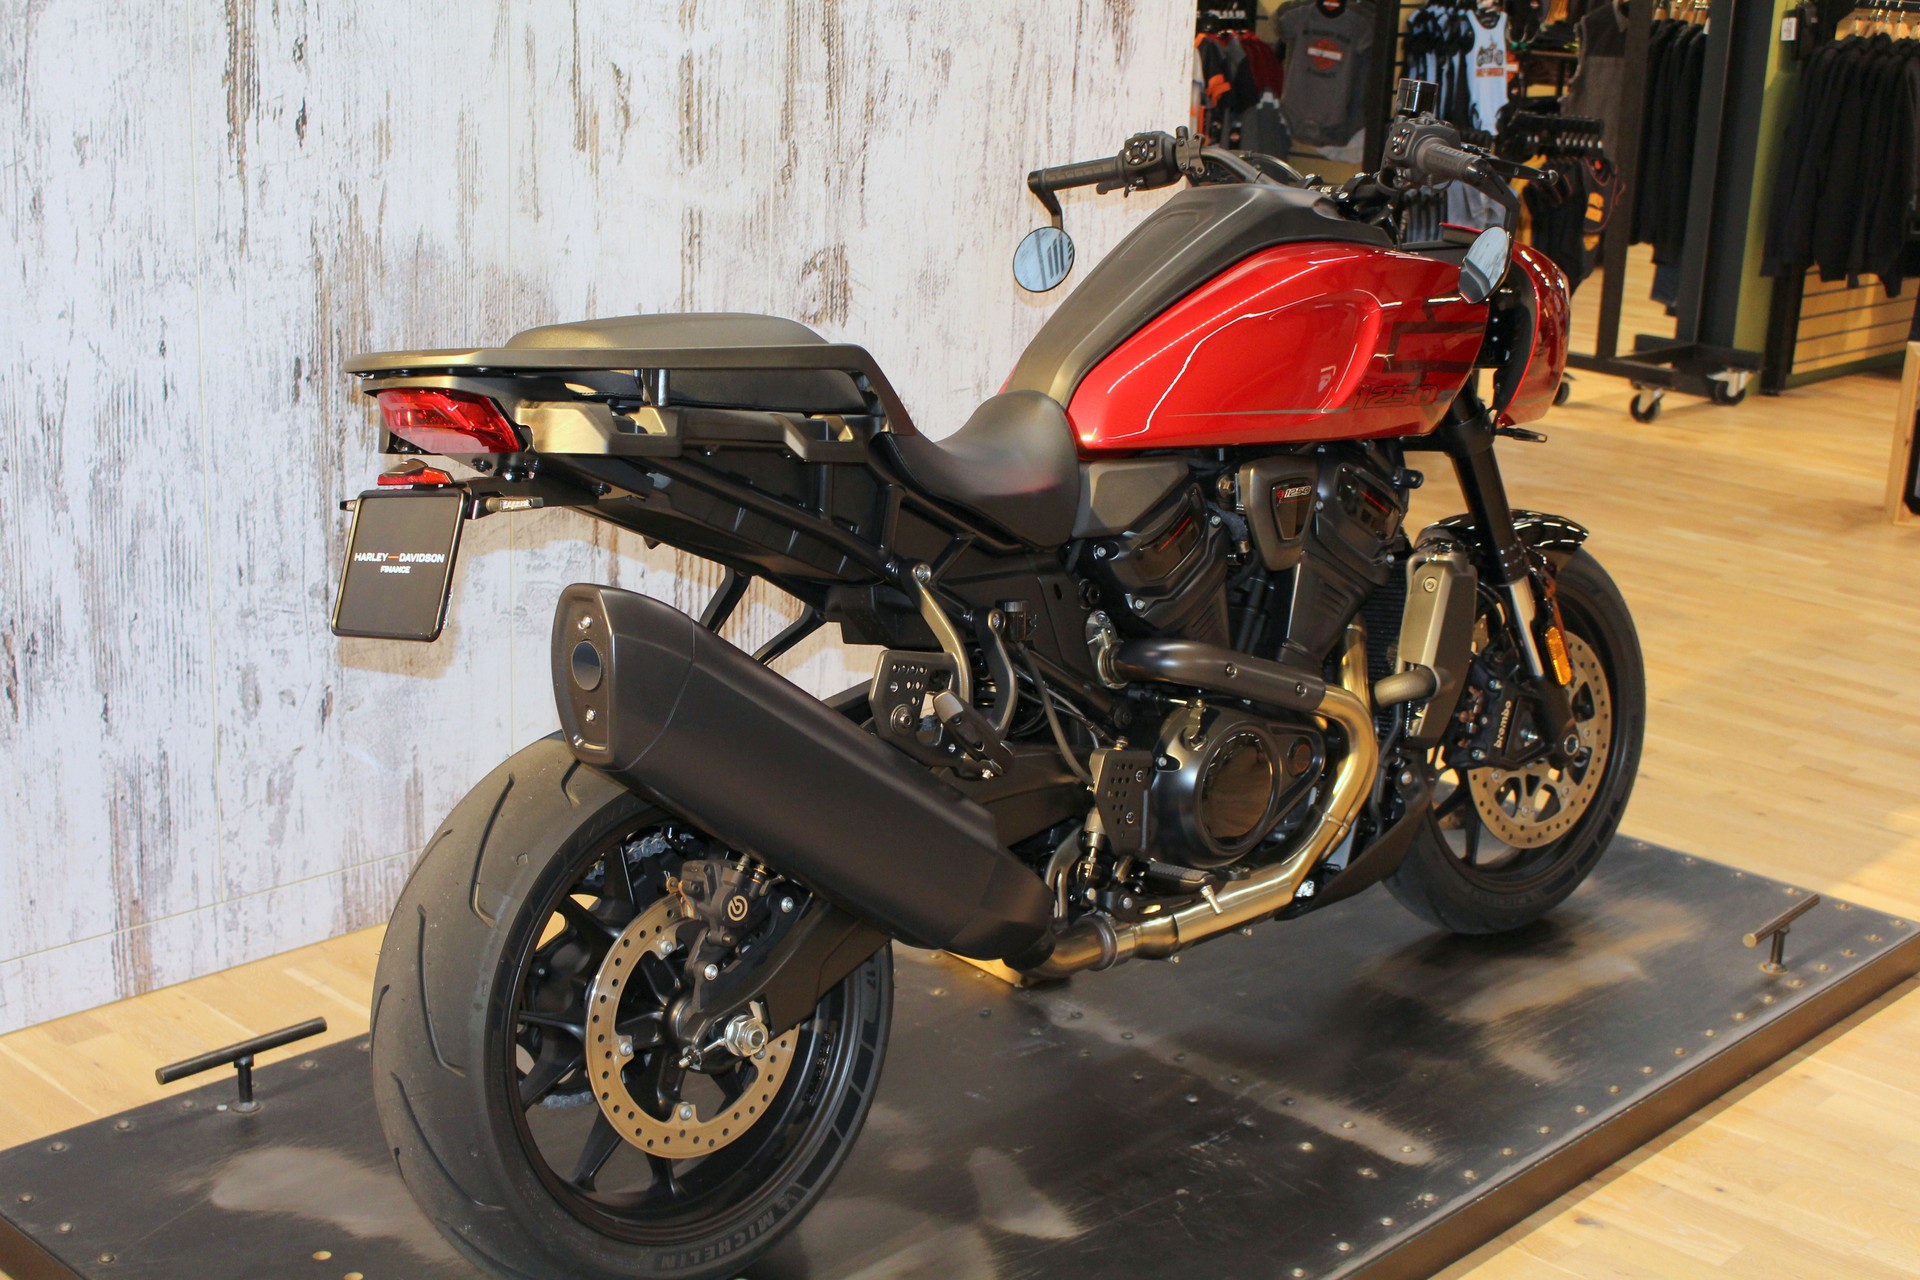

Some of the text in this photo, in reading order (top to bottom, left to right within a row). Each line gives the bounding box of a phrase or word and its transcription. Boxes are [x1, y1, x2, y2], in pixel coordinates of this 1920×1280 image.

[1353, 383, 1439, 411] 1250
[1284, 485, 1312, 498] 1250
[380, 565, 411, 574] FINANCE
[1493, 700, 1512, 748] brembo
[660, 1209, 776, 1269] MICHELIN
